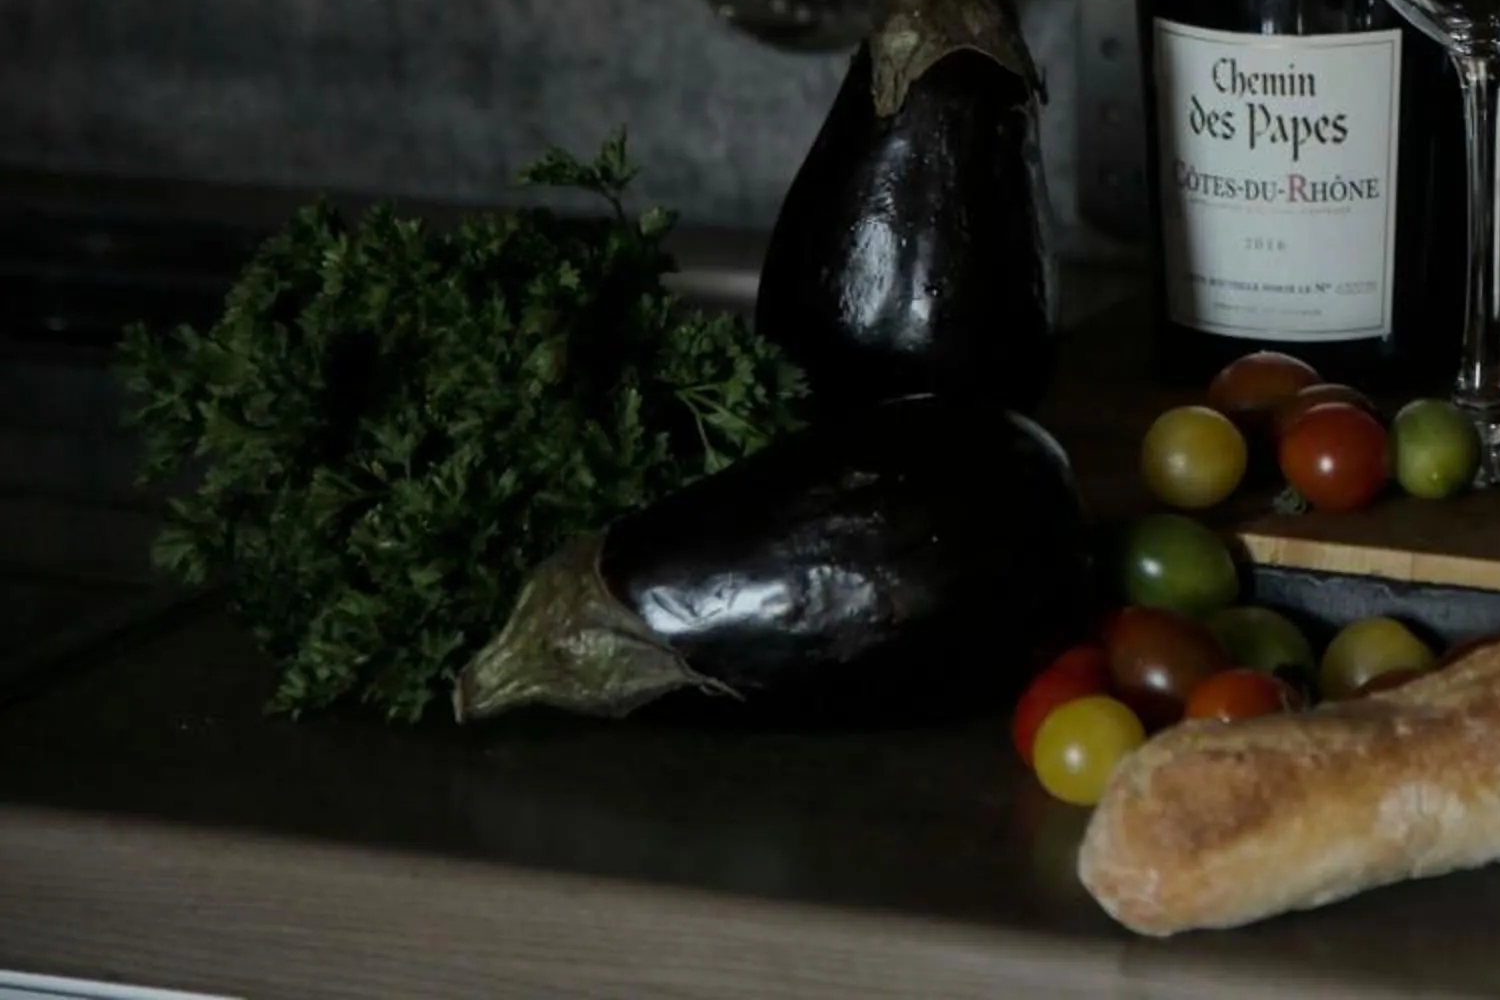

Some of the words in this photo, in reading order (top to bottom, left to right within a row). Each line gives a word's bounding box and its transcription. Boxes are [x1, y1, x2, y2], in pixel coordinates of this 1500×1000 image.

[1212, 57, 1317, 98] Chemin
[1190, 95, 1236, 140] des
[1246, 102, 1349, 162] Papes
